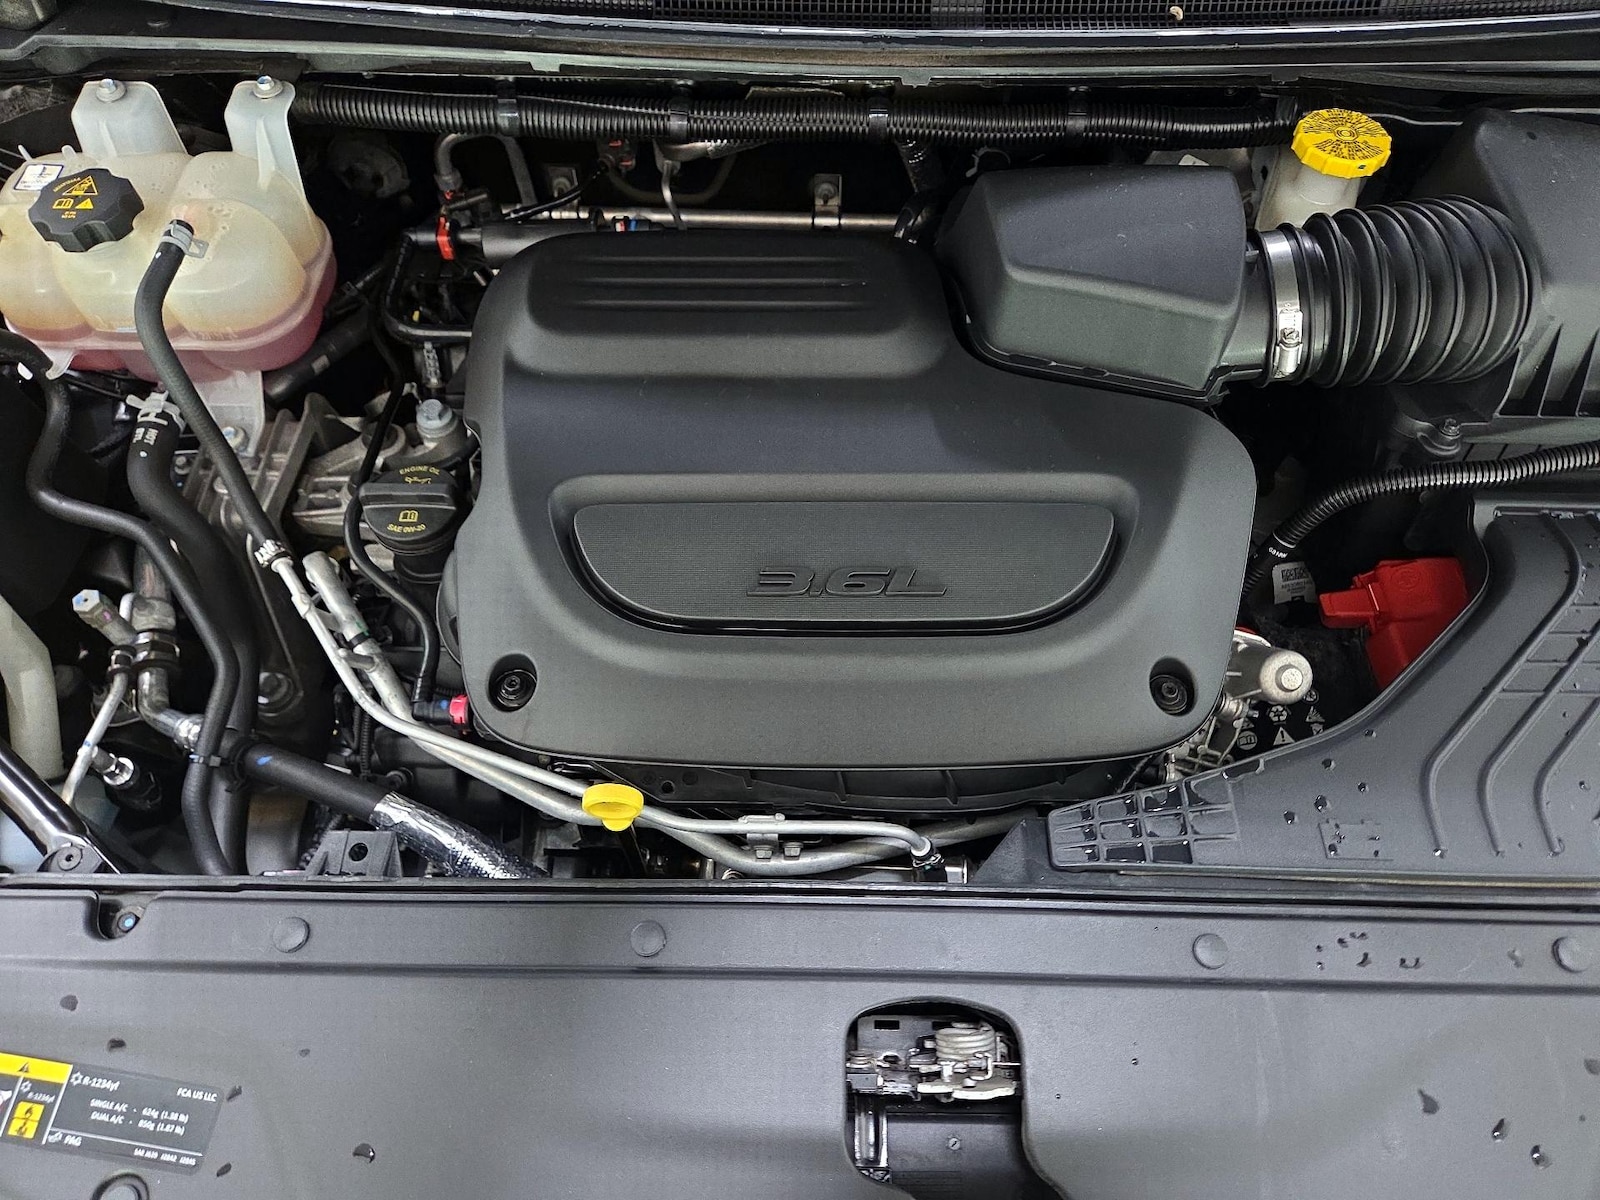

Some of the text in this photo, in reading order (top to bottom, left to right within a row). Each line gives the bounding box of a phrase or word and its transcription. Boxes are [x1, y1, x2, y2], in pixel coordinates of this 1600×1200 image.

[399, 465, 429, 475] ENGINE
[746, 566, 948, 597] 3.6L
[176, 1087, 218, 1102] FCA US LLC
[90, 1110, 112, 1122] DUAL
[63, 1134, 82, 1147] PAG
